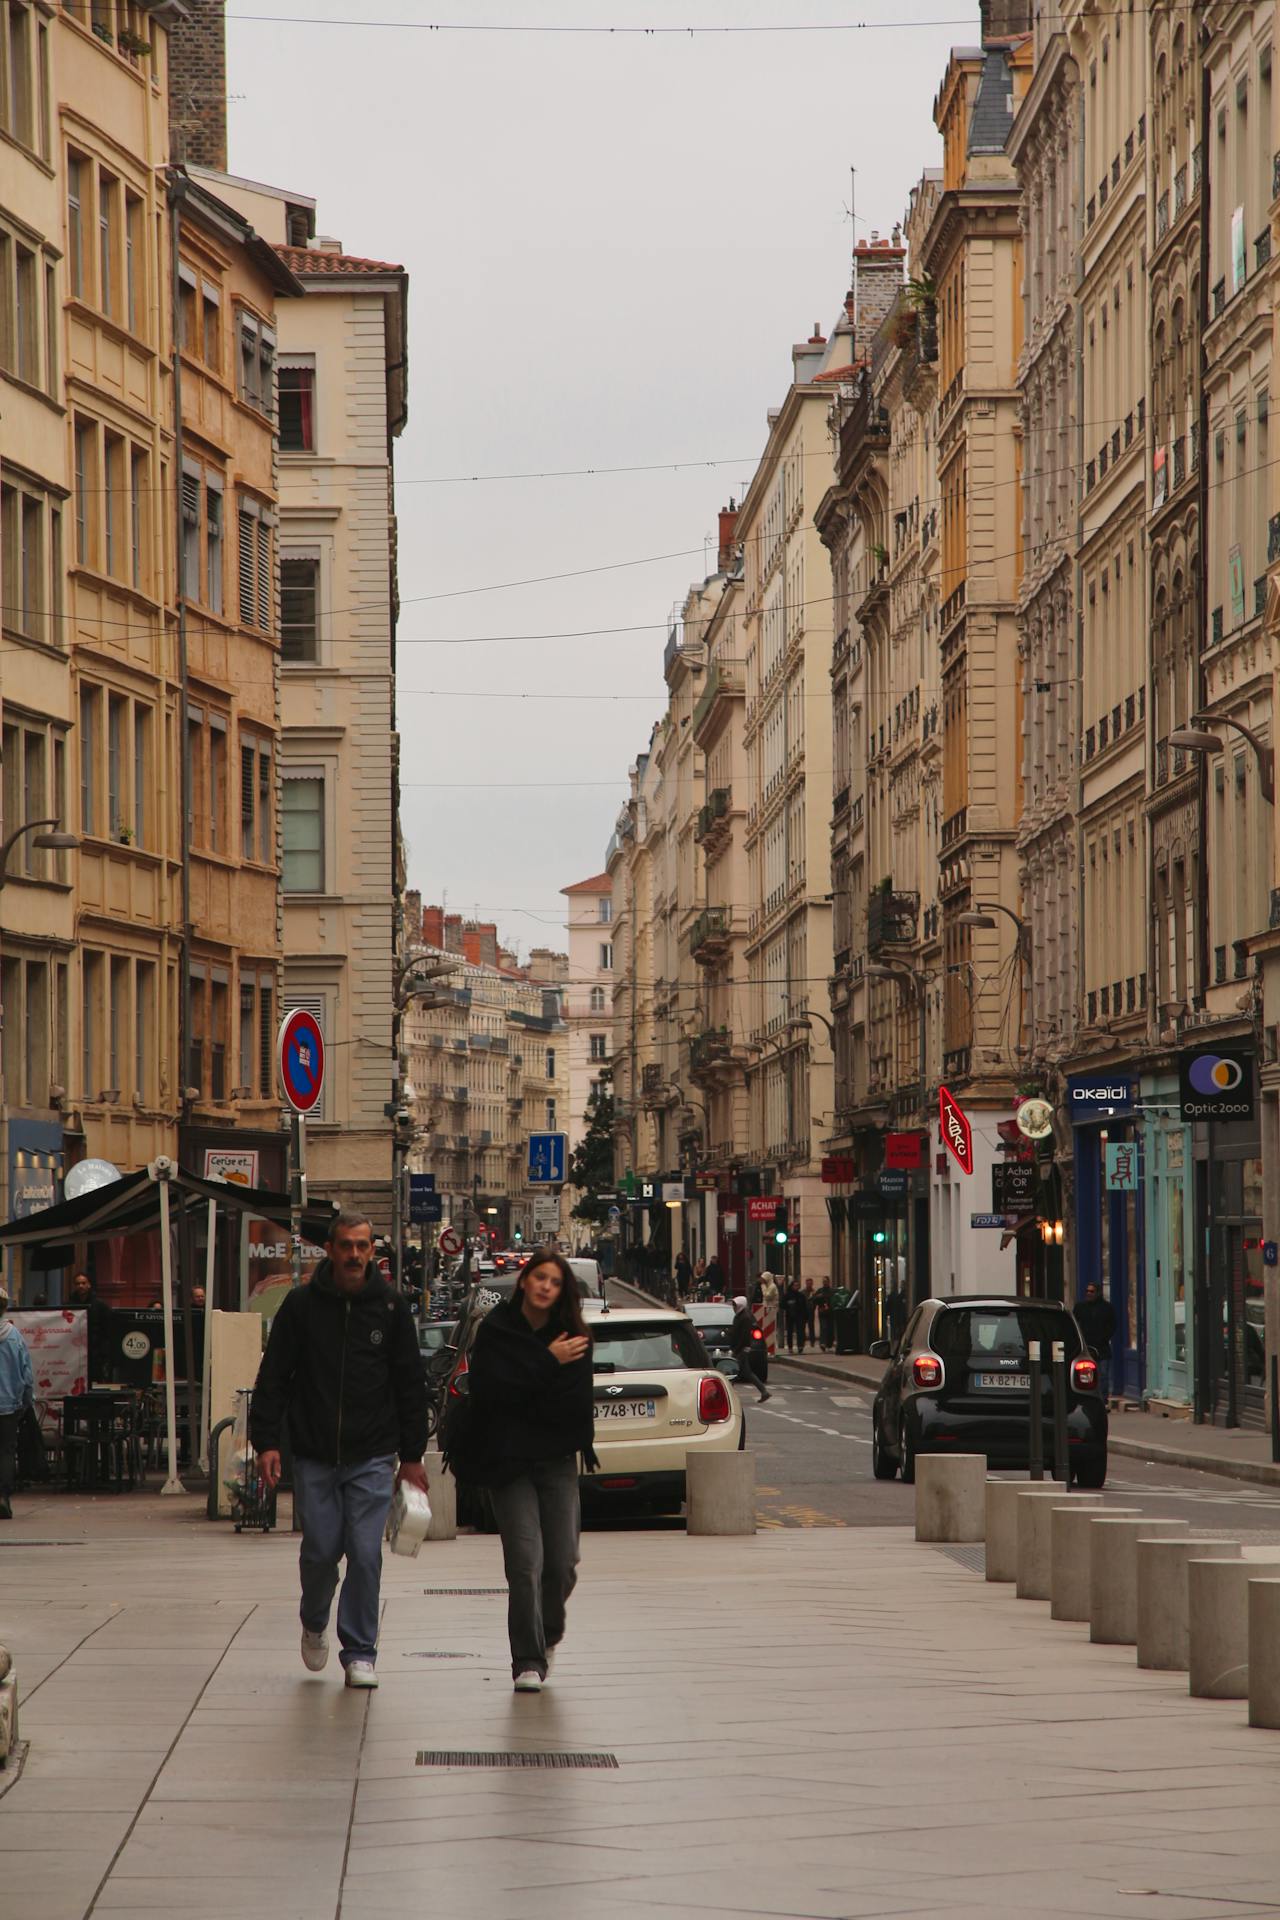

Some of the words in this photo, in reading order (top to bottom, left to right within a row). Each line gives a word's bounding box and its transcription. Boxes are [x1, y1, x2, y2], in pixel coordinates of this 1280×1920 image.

[1072, 1085, 1127, 1100] okaïdi
[1183, 1102, 1217, 1116] Optic
[1220, 1102, 1249, 1113] 2000
[944, 1105, 967, 1156] TABAC
[211, 1156, 236, 1166] Cerise
[1007, 1166, 1033, 1176] Achat
[1012, 1177, 1028, 1188] OR
[751, 1201, 776, 1210] ACHAT
